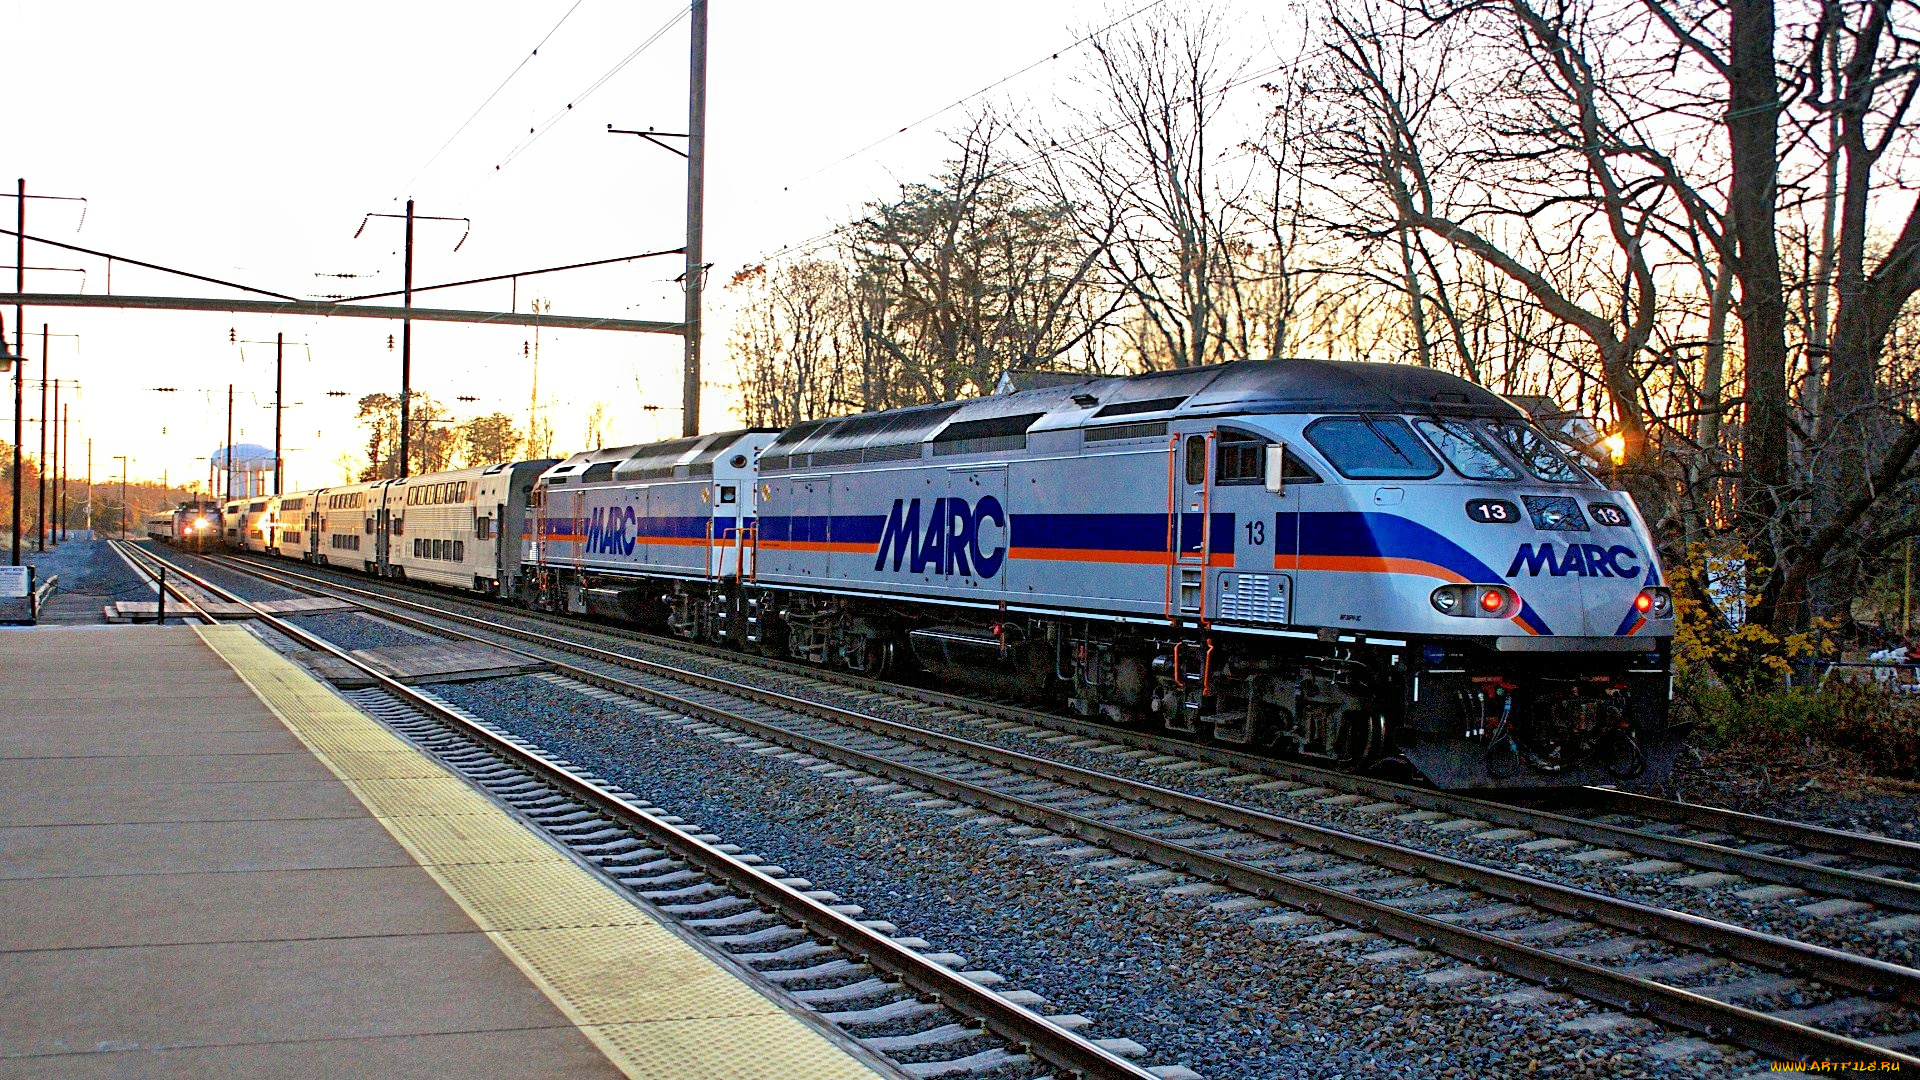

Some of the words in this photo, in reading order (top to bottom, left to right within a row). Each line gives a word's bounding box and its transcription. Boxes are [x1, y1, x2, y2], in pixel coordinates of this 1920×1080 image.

[1479, 504, 1506, 519] 13
[1598, 508, 1620, 523] 13
[586, 506, 637, 556] MARC
[874, 495, 1006, 579] MARC
[1245, 521, 1265, 545] 13
[1505, 543, 1641, 579] MARC
